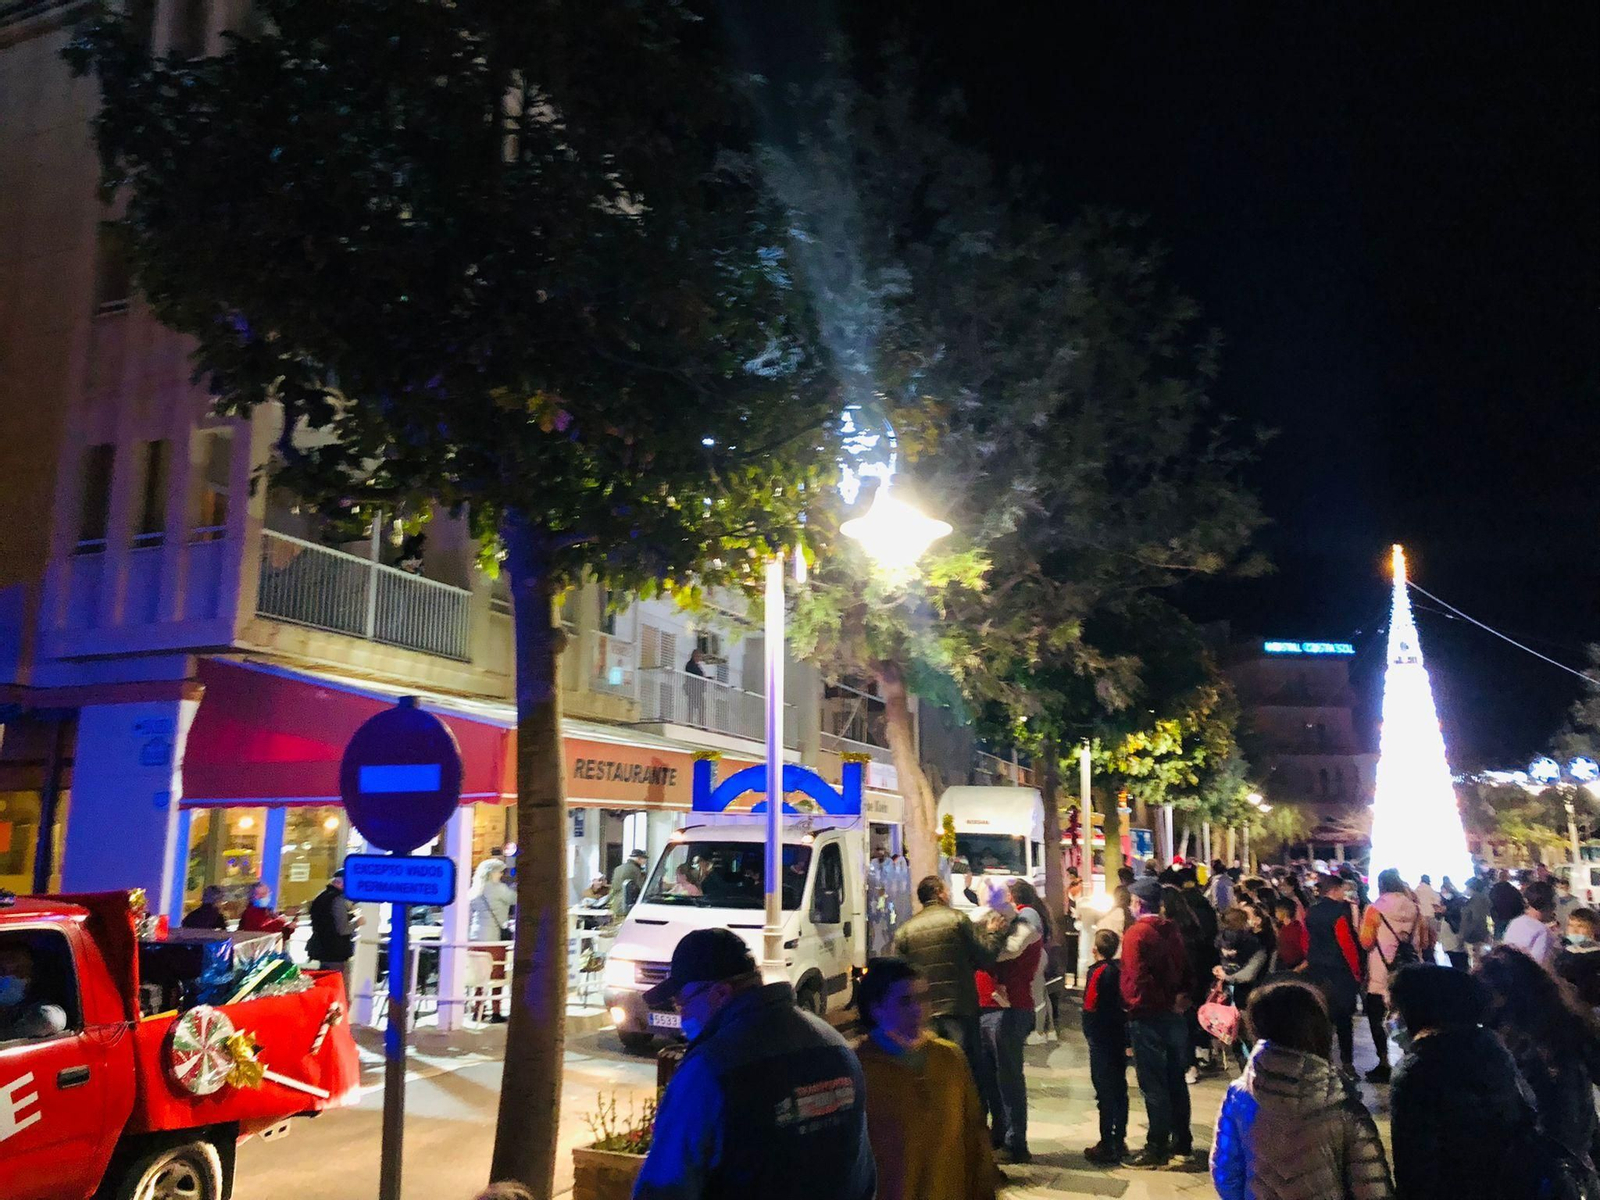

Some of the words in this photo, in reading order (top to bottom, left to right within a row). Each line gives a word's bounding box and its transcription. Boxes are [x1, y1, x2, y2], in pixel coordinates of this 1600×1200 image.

[573, 758, 677, 786] RESTAURANTE
[353, 863, 403, 877] EXCEPTO
[405, 864, 444, 878] VADOS
[357, 880, 439, 895] PERMANENTES
